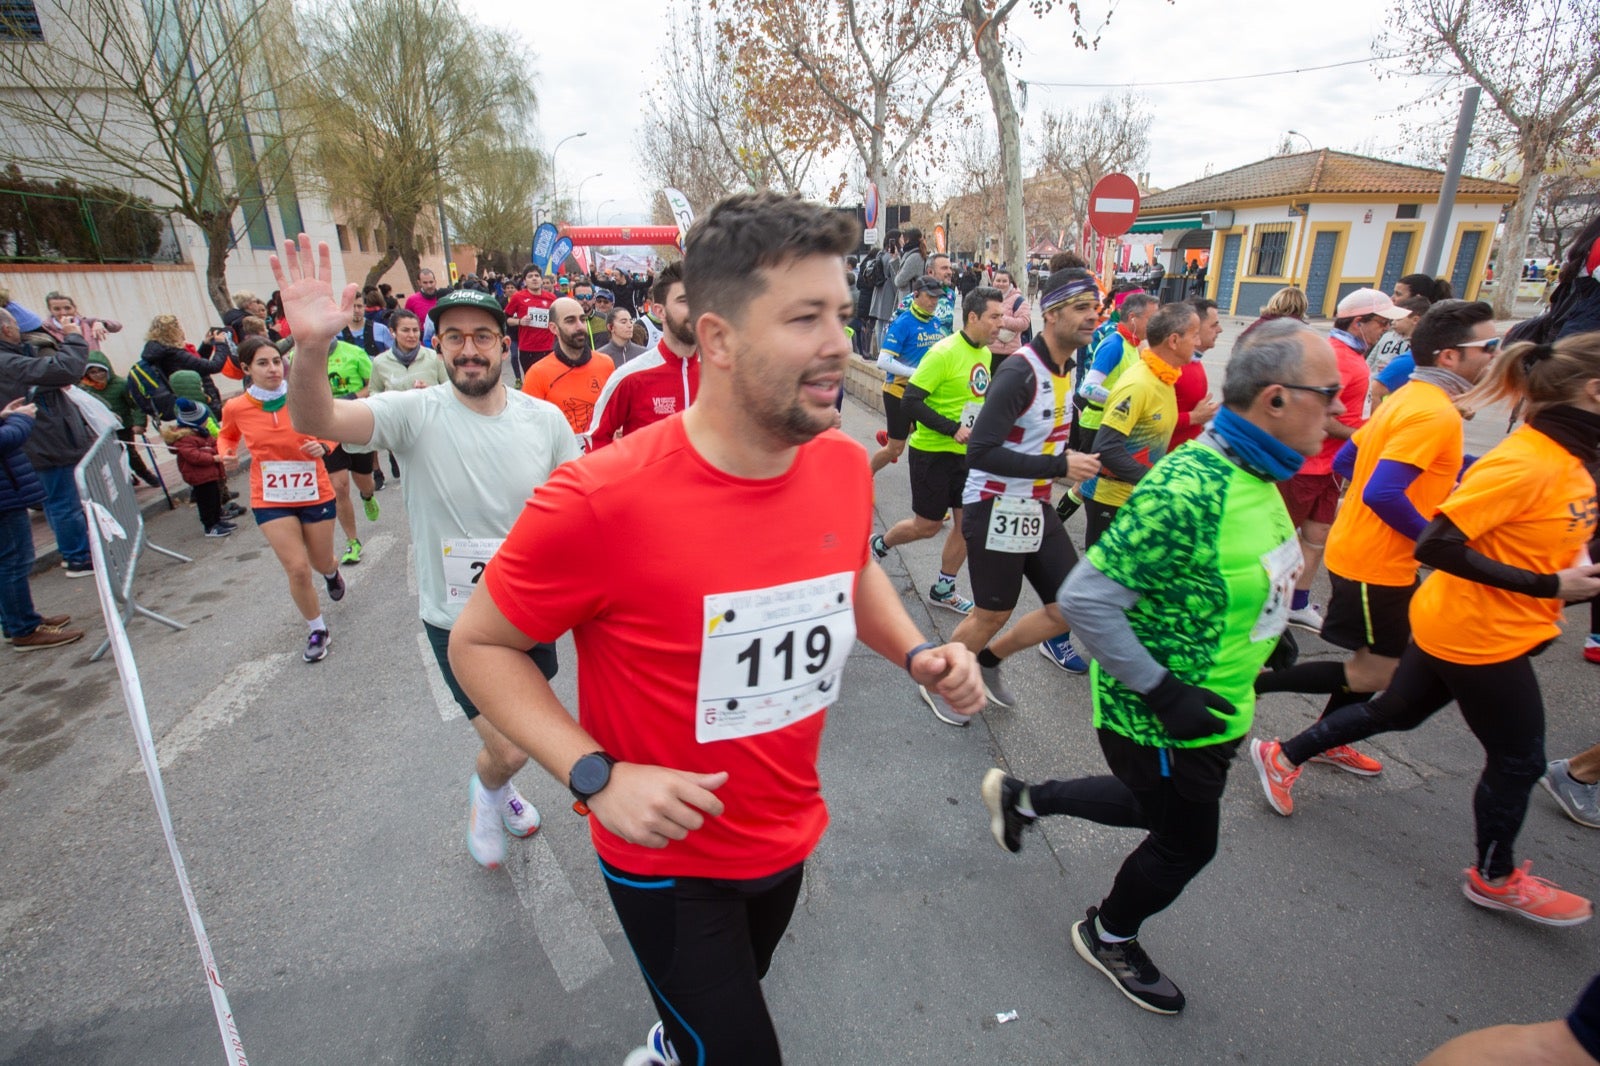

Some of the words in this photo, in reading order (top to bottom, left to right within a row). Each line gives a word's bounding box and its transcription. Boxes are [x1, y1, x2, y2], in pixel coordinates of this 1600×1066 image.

[266, 472, 314, 488] 2172
[994, 515, 1041, 536] 3169
[737, 625, 832, 687] 119
